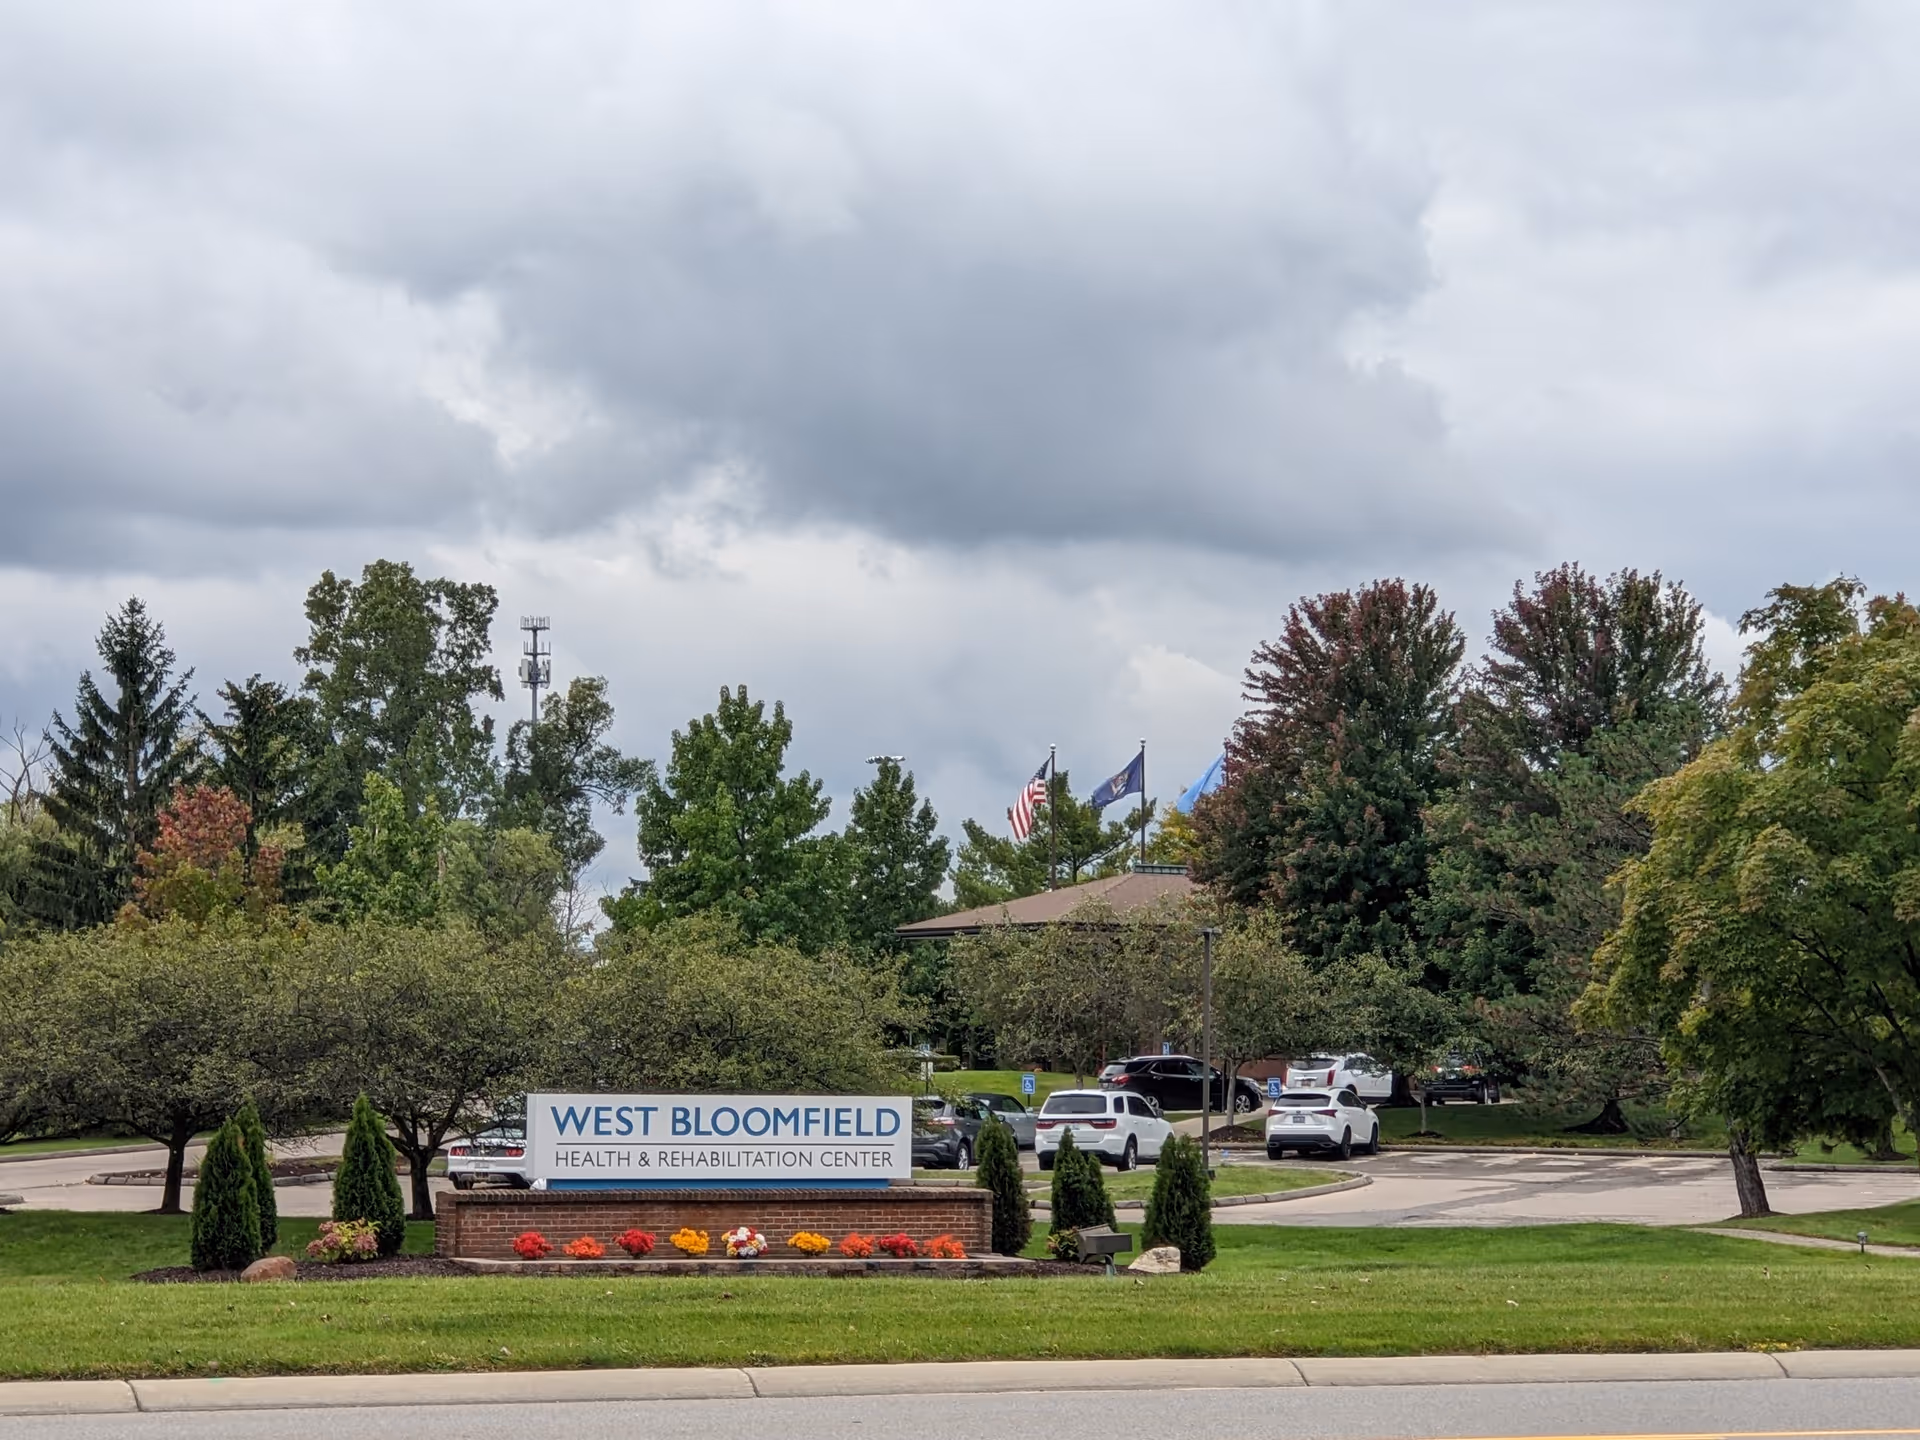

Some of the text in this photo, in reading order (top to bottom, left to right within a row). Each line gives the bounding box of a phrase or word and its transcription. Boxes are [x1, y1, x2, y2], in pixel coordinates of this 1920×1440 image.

[550, 1106, 901, 1137] WEST BLOOMFIELD
[555, 1150, 893, 1168] HEALTH & REHABILITATION CENTER
